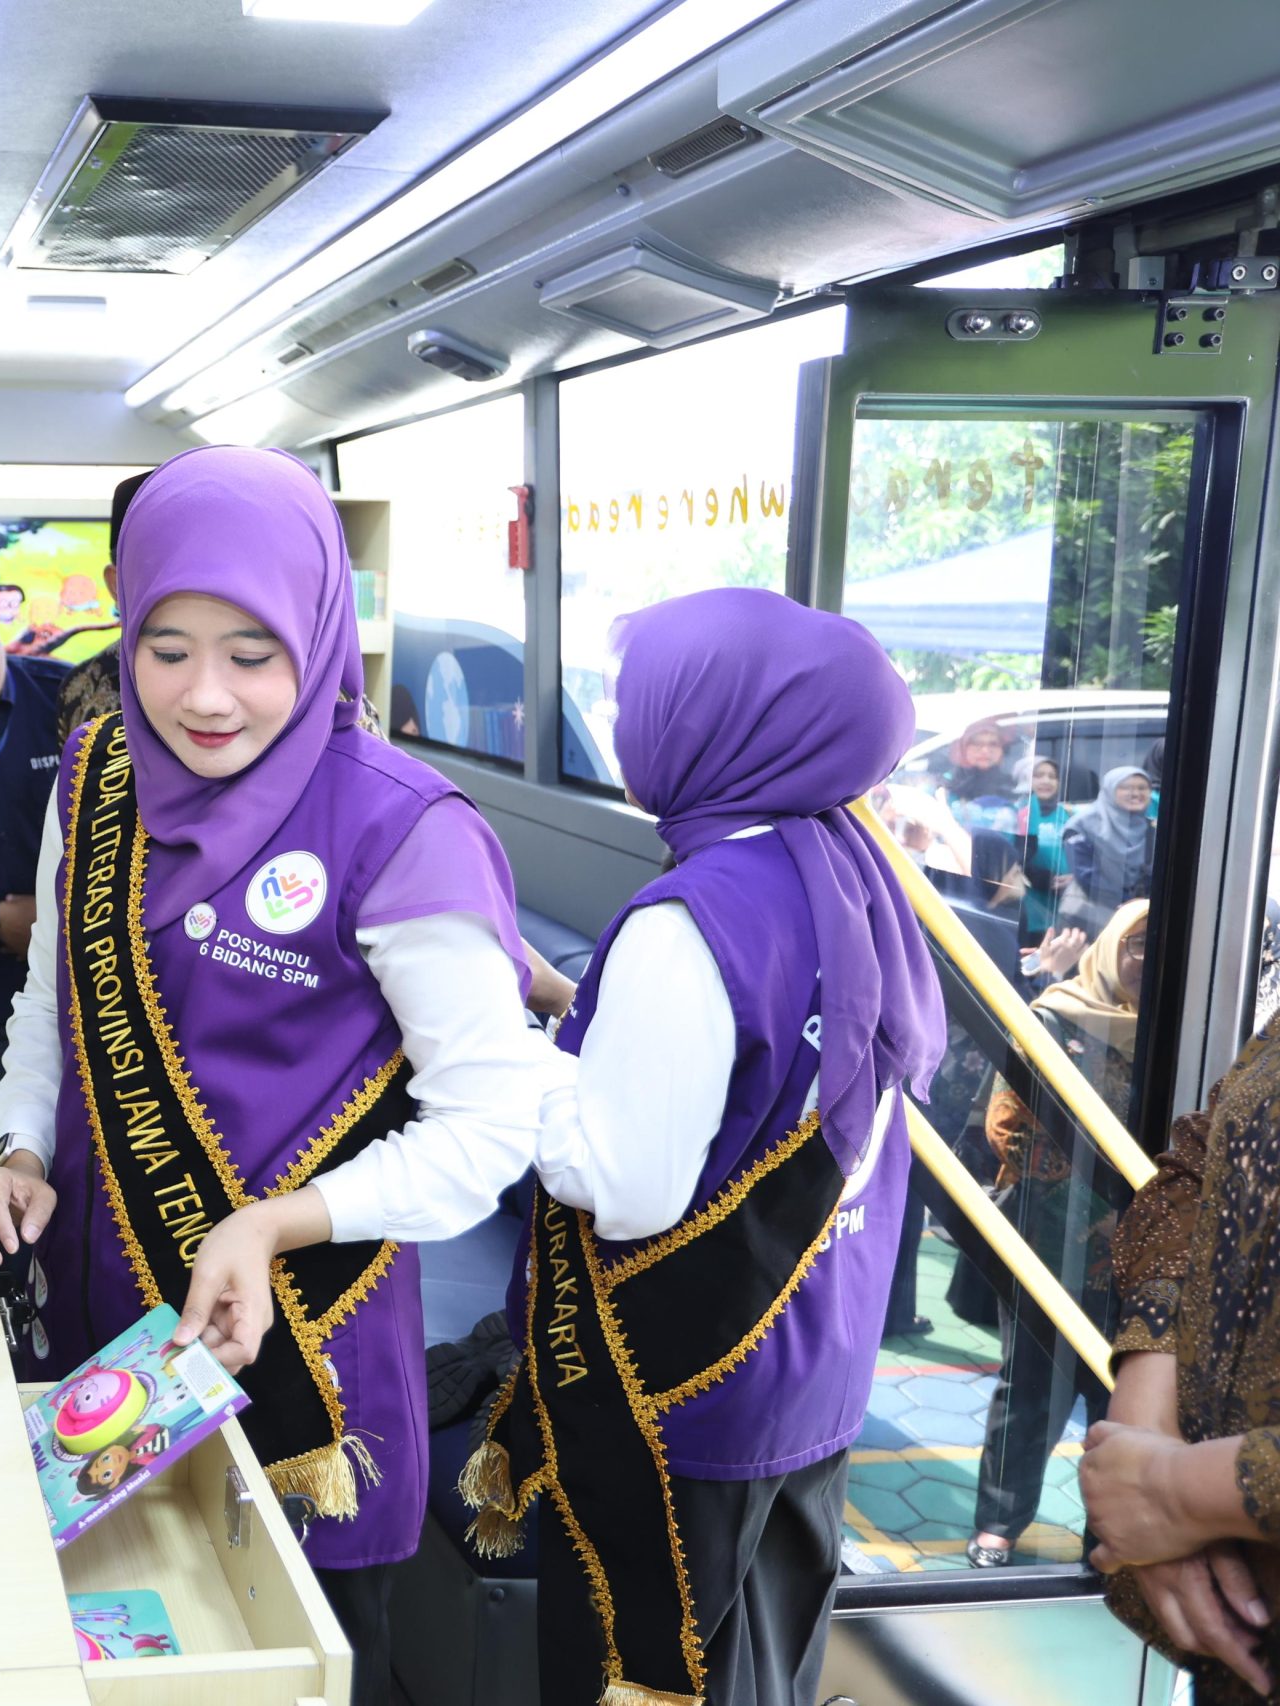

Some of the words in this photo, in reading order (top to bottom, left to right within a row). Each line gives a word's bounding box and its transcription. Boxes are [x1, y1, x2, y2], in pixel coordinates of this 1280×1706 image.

[83, 810, 122, 933] LITERASI
[199, 942, 210, 956] 6
[211, 945, 278, 979] BIDANG
[281, 968, 319, 988] SPM
[217, 929, 310, 969] POSYANDU
[85, 935, 145, 1080] PROVINSI
[114, 1086, 181, 1175] JAWA
